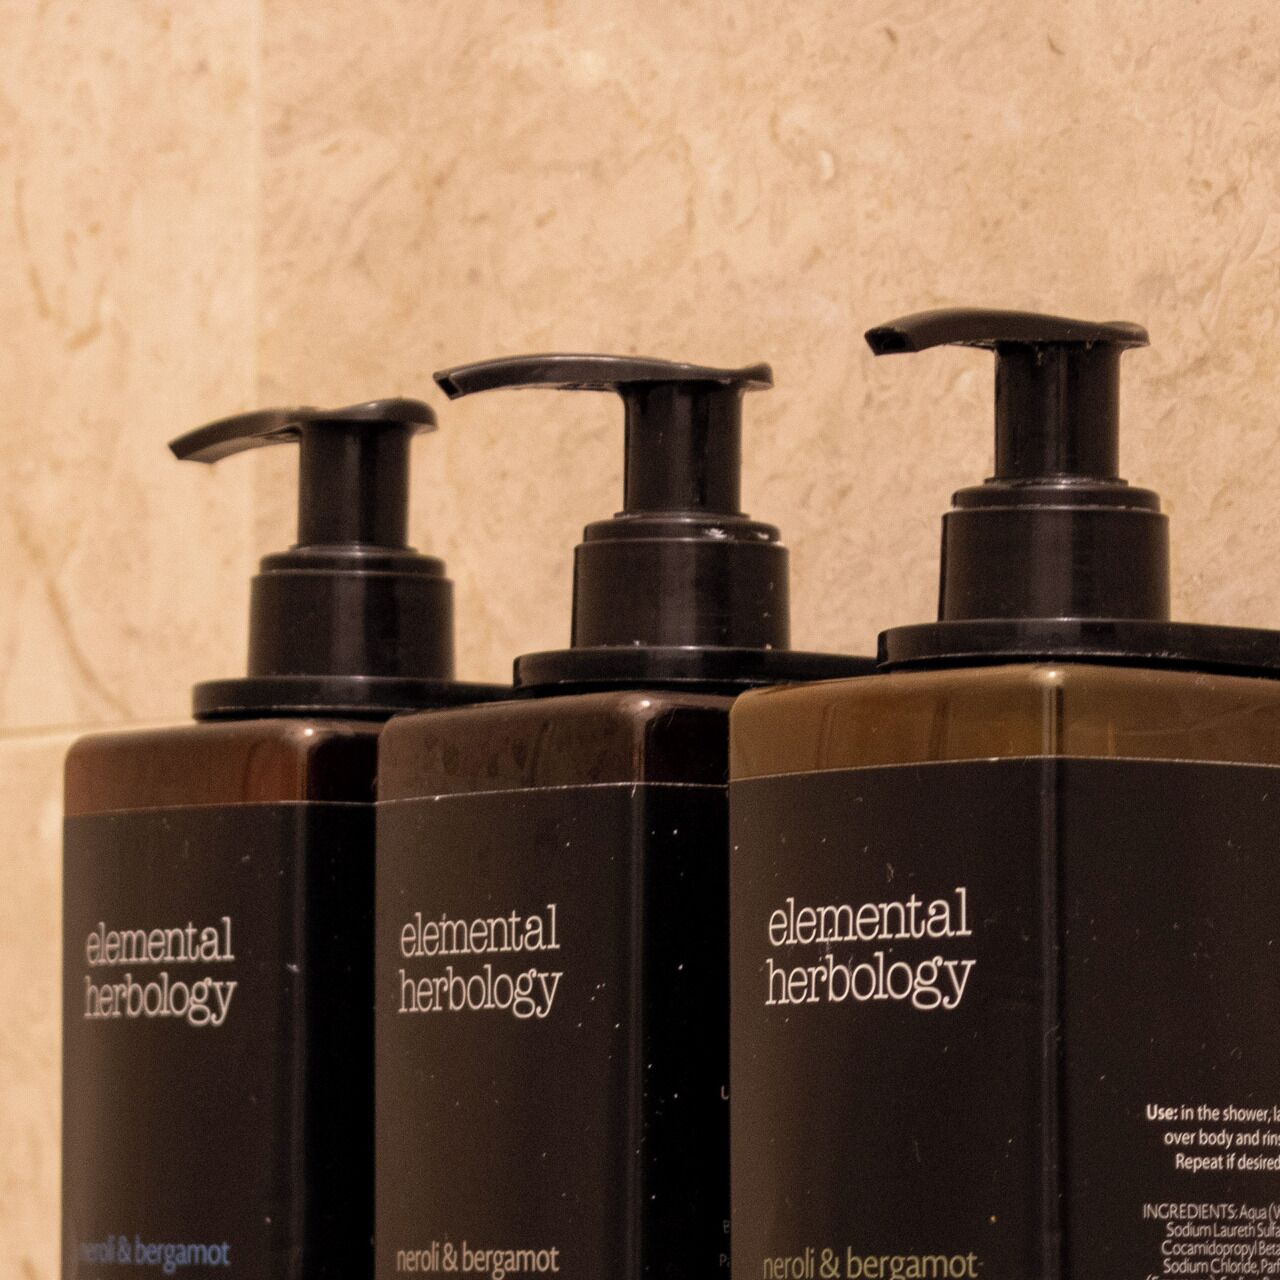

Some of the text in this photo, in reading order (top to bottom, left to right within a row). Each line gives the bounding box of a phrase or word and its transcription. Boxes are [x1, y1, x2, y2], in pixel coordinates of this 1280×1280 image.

[401, 904, 560, 957] elemental
[769, 887, 972, 946] elemental
[86, 916, 235, 964] elemental
[398, 964, 564, 1018] herbology
[765, 951, 976, 1010] herbology
[83, 972, 237, 1026] herbology
[1146, 1104, 1178, 1120] Use:
[1181, 1104, 1193, 1120] in
[1197, 1105, 1220, 1121] the
[1222, 1104, 1271, 1124] shower,
[1164, 1131, 1196, 1146] over
[1199, 1128, 1233, 1150] body
[1236, 1130, 1259, 1146] and
[1176, 1153, 1224, 1173] Repeat
[1227, 1153, 1235, 1169] if
[1143, 1203, 1239, 1220] INGREDIENTS:
[1239, 1204, 1267, 1223] Aqua
[1166, 1222, 1211, 1238] Sodium
[1213, 1222, 1255, 1238] Laureth
[118, 1236, 131, 1263] &
[135, 1235, 230, 1274] bergamot
[397, 1240, 439, 1271] neroli
[442, 1242, 458, 1271] &
[763, 1246, 814, 1280] neroli
[820, 1248, 840, 1279] &
[1161, 1240, 1257, 1260] Cocamidopropyl
[1163, 1257, 1208, 1273] Sodium
[1210, 1258, 1259, 1275] Chloride,
